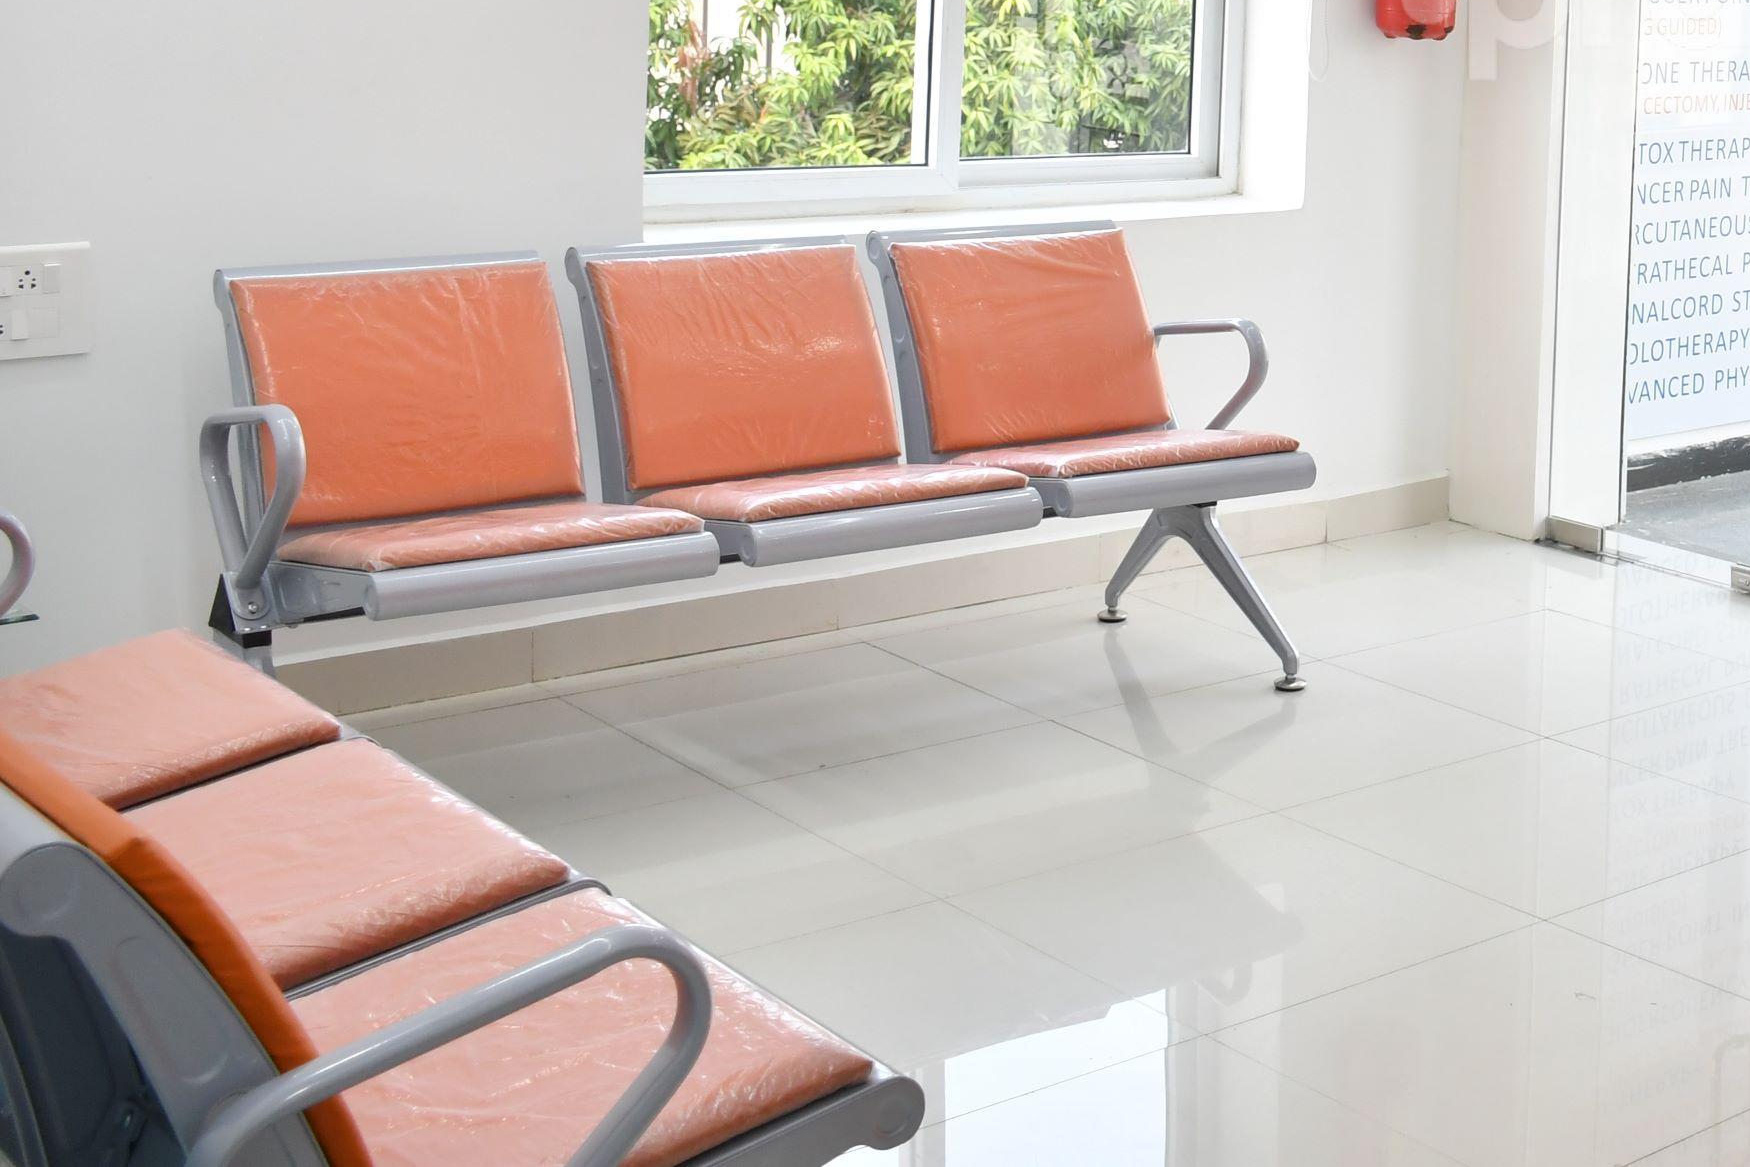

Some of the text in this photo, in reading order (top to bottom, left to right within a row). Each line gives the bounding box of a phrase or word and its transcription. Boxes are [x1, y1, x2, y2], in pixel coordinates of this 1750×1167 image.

[1639, 141, 1675, 165] TOX
[1689, 177, 1732, 201] PAIN
[1633, 253, 1733, 286] RATHECAL
[1631, 293, 1723, 325] NALCORD
[1628, 372, 1704, 404] VANCED
